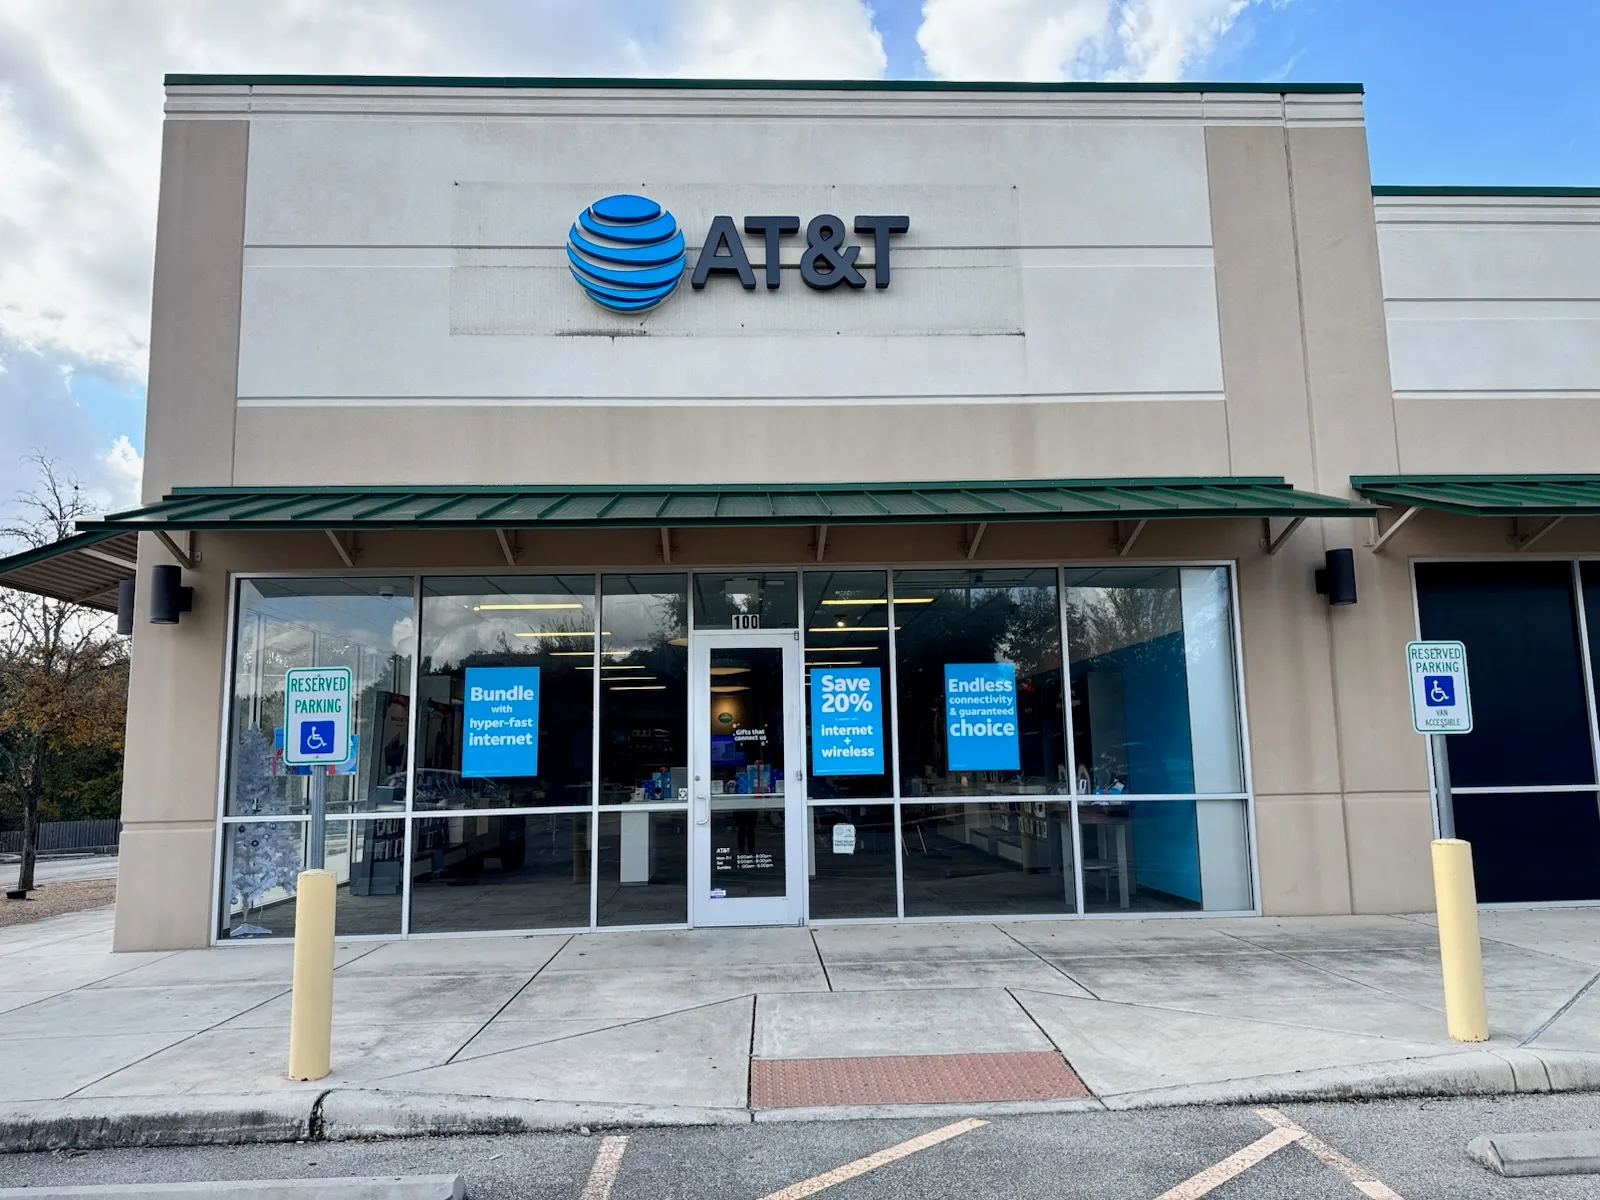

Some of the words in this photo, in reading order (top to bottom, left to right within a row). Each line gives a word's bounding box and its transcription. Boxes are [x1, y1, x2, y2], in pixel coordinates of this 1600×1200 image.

[691, 214, 909, 290] AT&T
[734, 615, 758, 629] 100
[1411, 648, 1461, 660] RESERVED
[1416, 661, 1459, 673] PARKING
[291, 677, 347, 692] RESERVED
[821, 674, 871, 692] Save
[948, 677, 1013, 693] Endless
[470, 685, 534, 702] Bundle
[949, 695, 1013, 706] connectivity
[294, 699, 342, 714] PARKING
[491, 704, 513, 713] with
[821, 693, 873, 713] 20%
[949, 707, 957, 716] &
[958, 707, 1014, 718] guaranteed
[469, 717, 533, 730] hyper-fast
[949, 718, 1015, 737] choice
[1425, 718, 1460, 727] ACCESSIBLE
[821, 724, 874, 736] internet
[469, 732, 533, 746] internet
[821, 745, 875, 758] wireless
